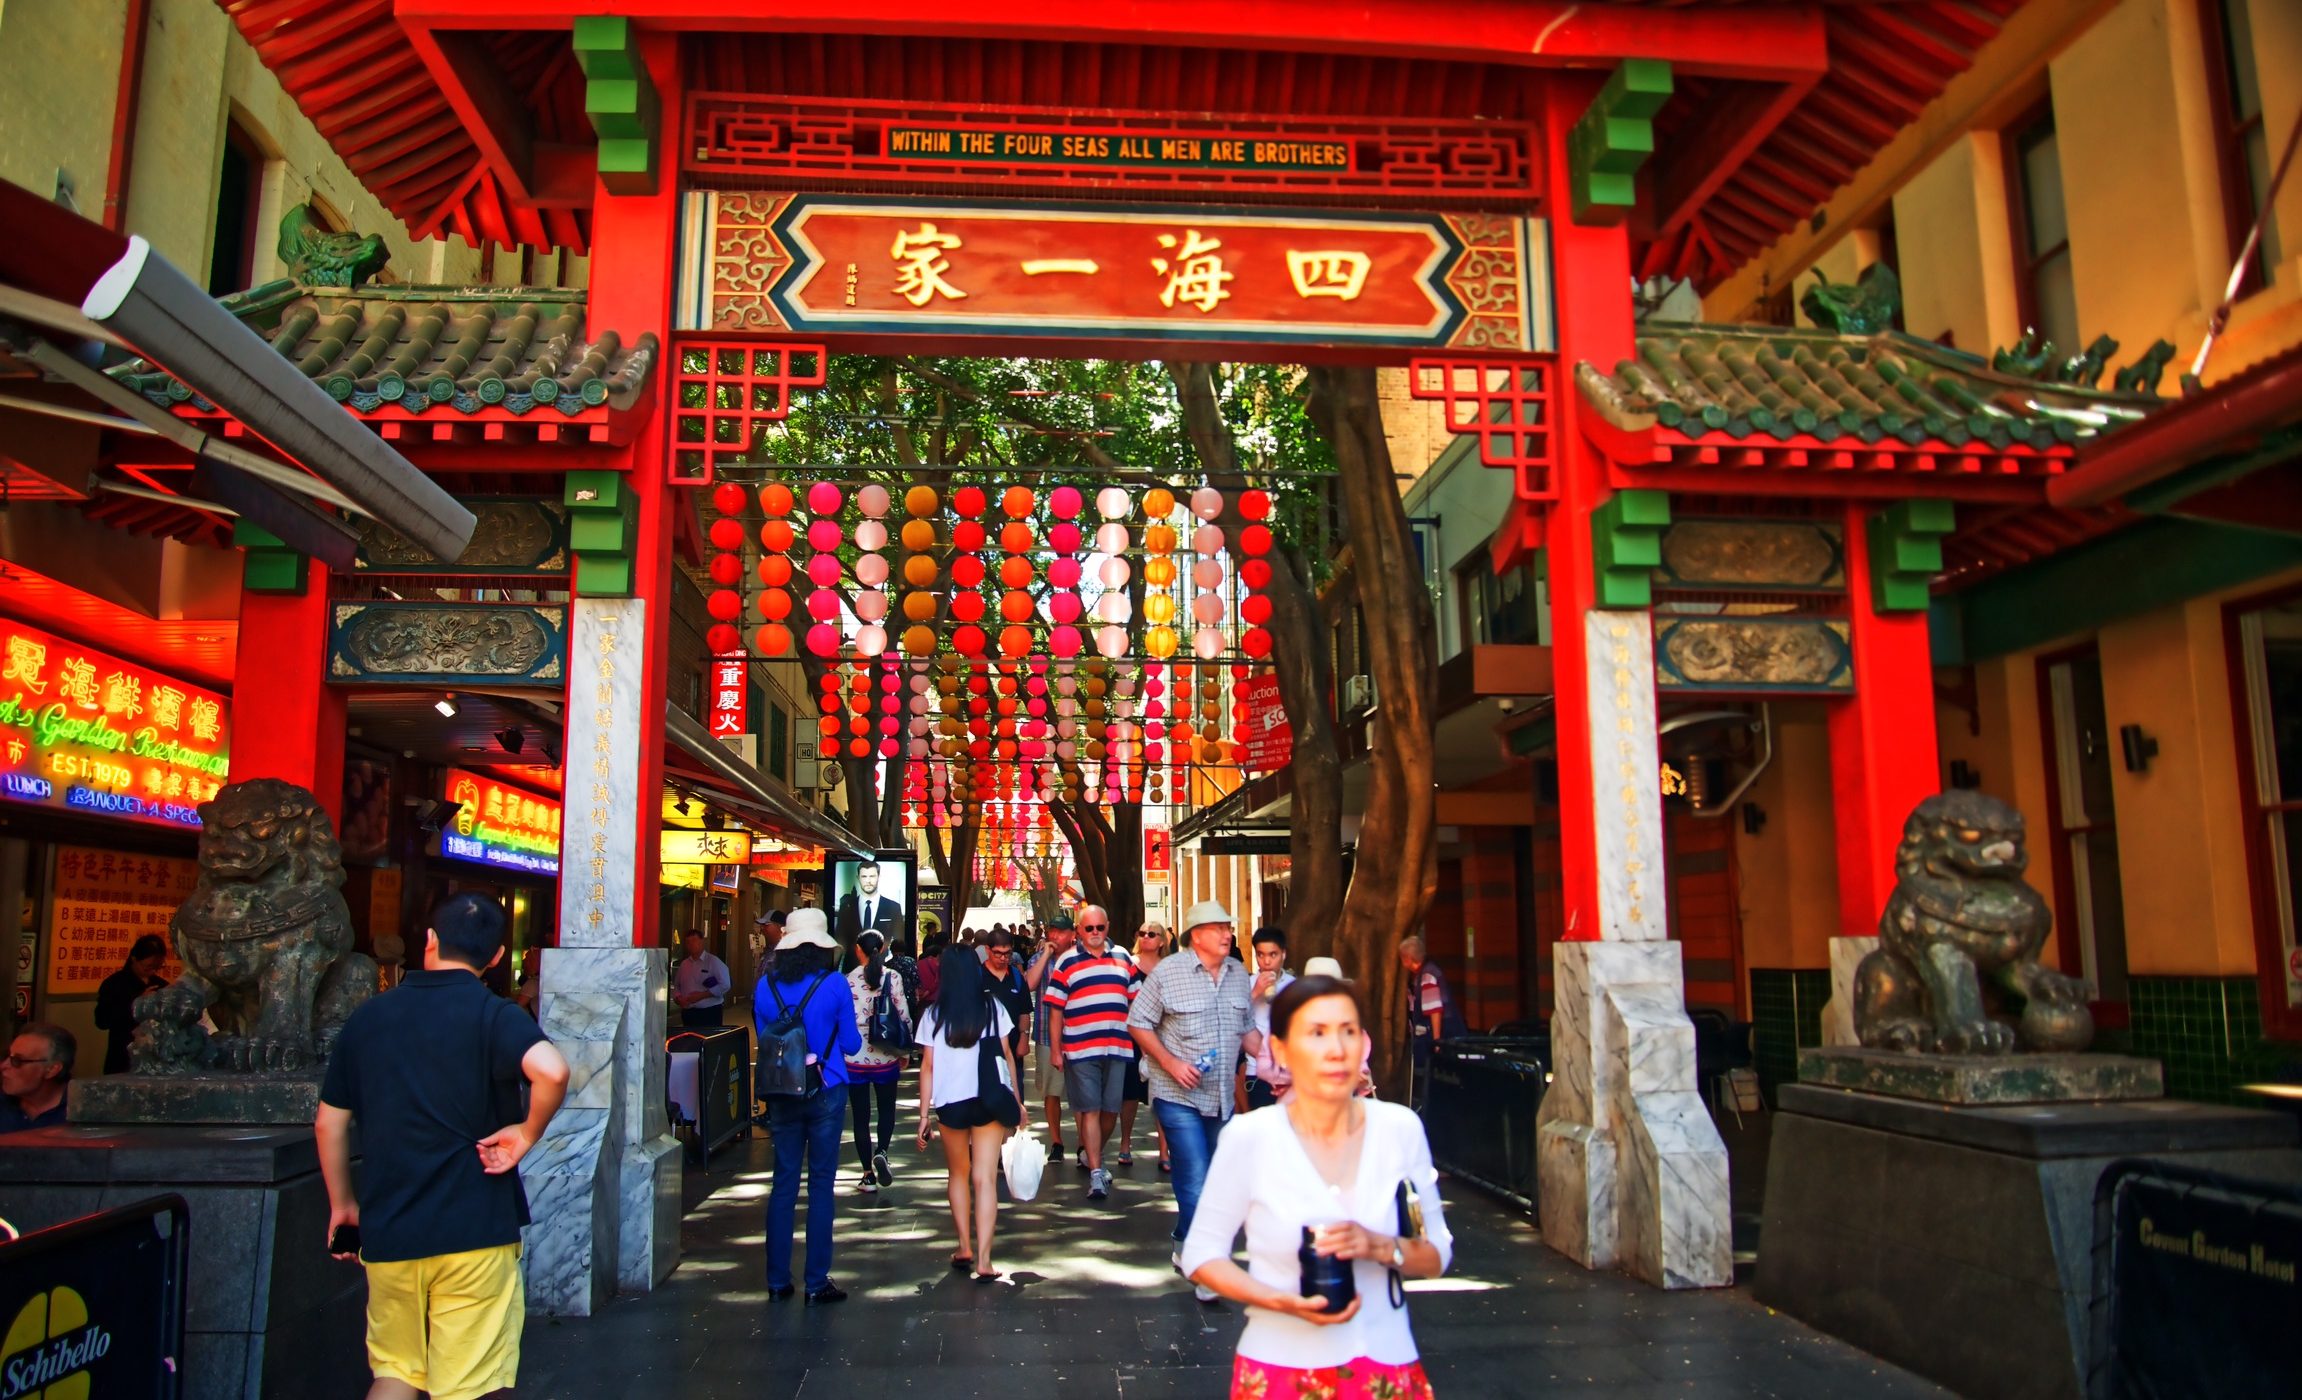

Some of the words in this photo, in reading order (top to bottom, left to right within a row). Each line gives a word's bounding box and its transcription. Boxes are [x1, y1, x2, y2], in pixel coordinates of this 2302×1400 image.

[891, 131, 951, 152] WITHIN
[960, 134, 995, 154] THE
[1004, 135, 1052, 155] FOUR
[1062, 137, 1109, 157] SEAS
[1118, 139, 1154, 159] ALL
[1161, 141, 1201, 160] MEN
[1210, 142, 1245, 161] ARE
[1254, 143, 1346, 165] BROTHERS
[715, 667, 743, 739] 重慶火
[1247, 686, 1280, 700] uction
[130, 728, 229, 777] Restauran
[2, 1325, 111, 1400] Schibello
